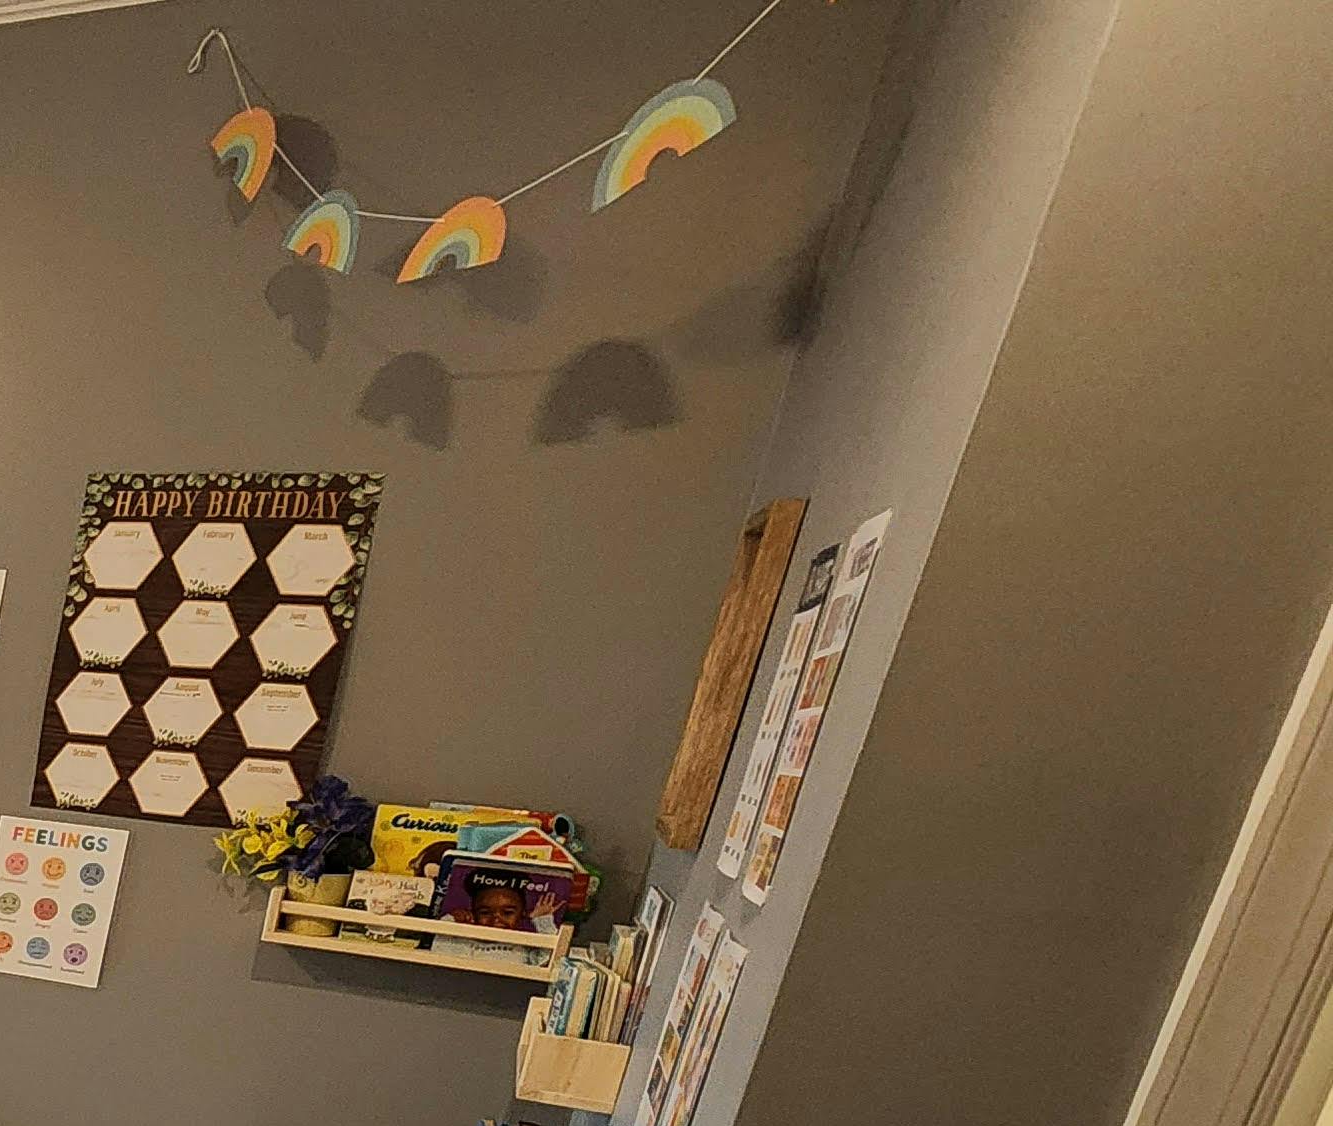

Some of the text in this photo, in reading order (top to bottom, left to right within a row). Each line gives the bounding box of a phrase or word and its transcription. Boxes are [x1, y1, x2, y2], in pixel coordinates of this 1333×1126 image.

[112, 490, 348, 519] HAPPY BIRTHDAY
[304, 531, 329, 541] March
[391, 813, 459, 833] Curious
[12, 826, 109, 852] FEELINGS
[519, 851, 538, 860] The
[472, 874, 550, 892] How I Feel
